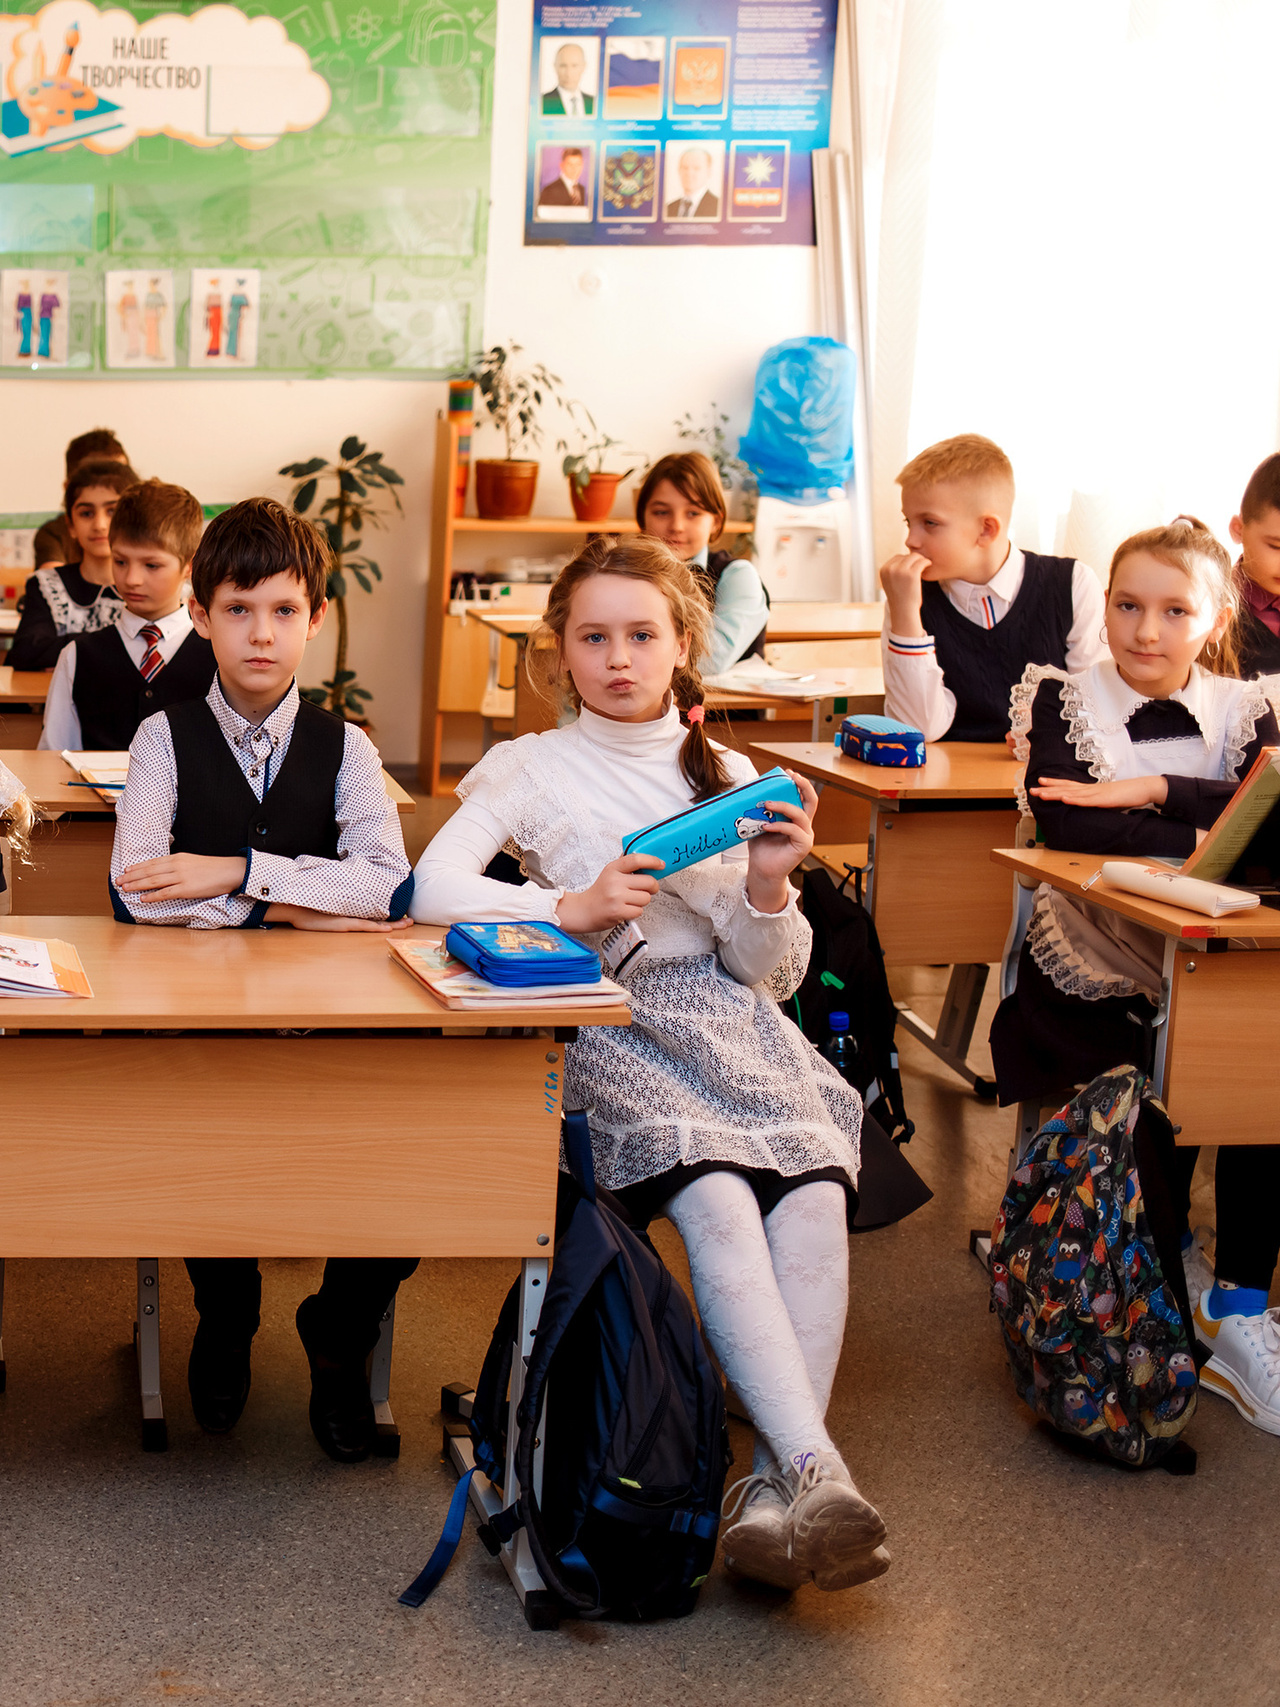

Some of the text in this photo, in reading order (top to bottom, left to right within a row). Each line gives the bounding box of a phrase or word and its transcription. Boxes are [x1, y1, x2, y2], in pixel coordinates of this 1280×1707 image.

[112, 37, 169, 60] НАШЕ
[80, 65, 201, 88] ТВОРЧЕСТВО
[672, 828, 728, 865] Hello!
